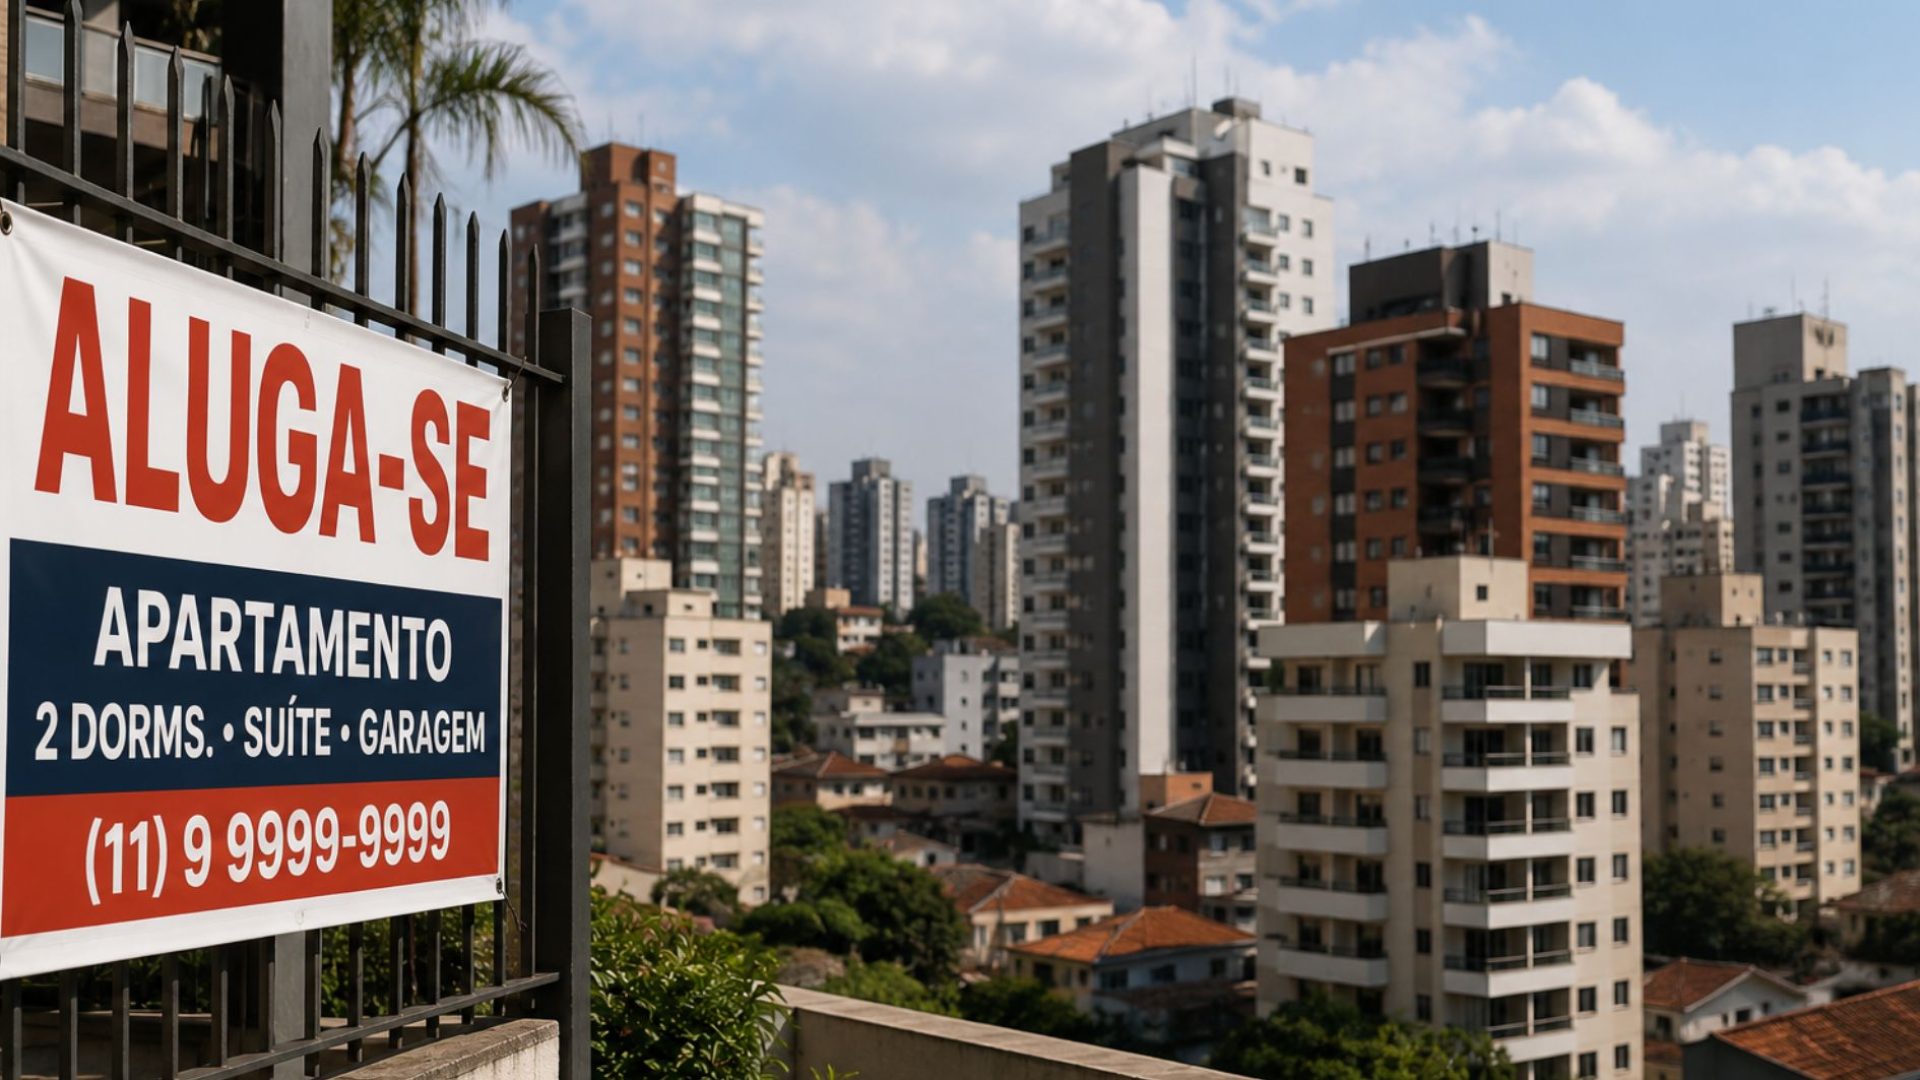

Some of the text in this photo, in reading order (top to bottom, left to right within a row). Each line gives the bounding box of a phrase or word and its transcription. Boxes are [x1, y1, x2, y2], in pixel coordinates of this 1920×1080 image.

[35, 277, 490, 560] ALUGA-SE
[94, 586, 452, 682] APARTAMENTO
[35, 695, 486, 760] 2 DORMS. SUÍTE GARAGEM
[86, 801, 450, 905] (11) 9 9999-9999
